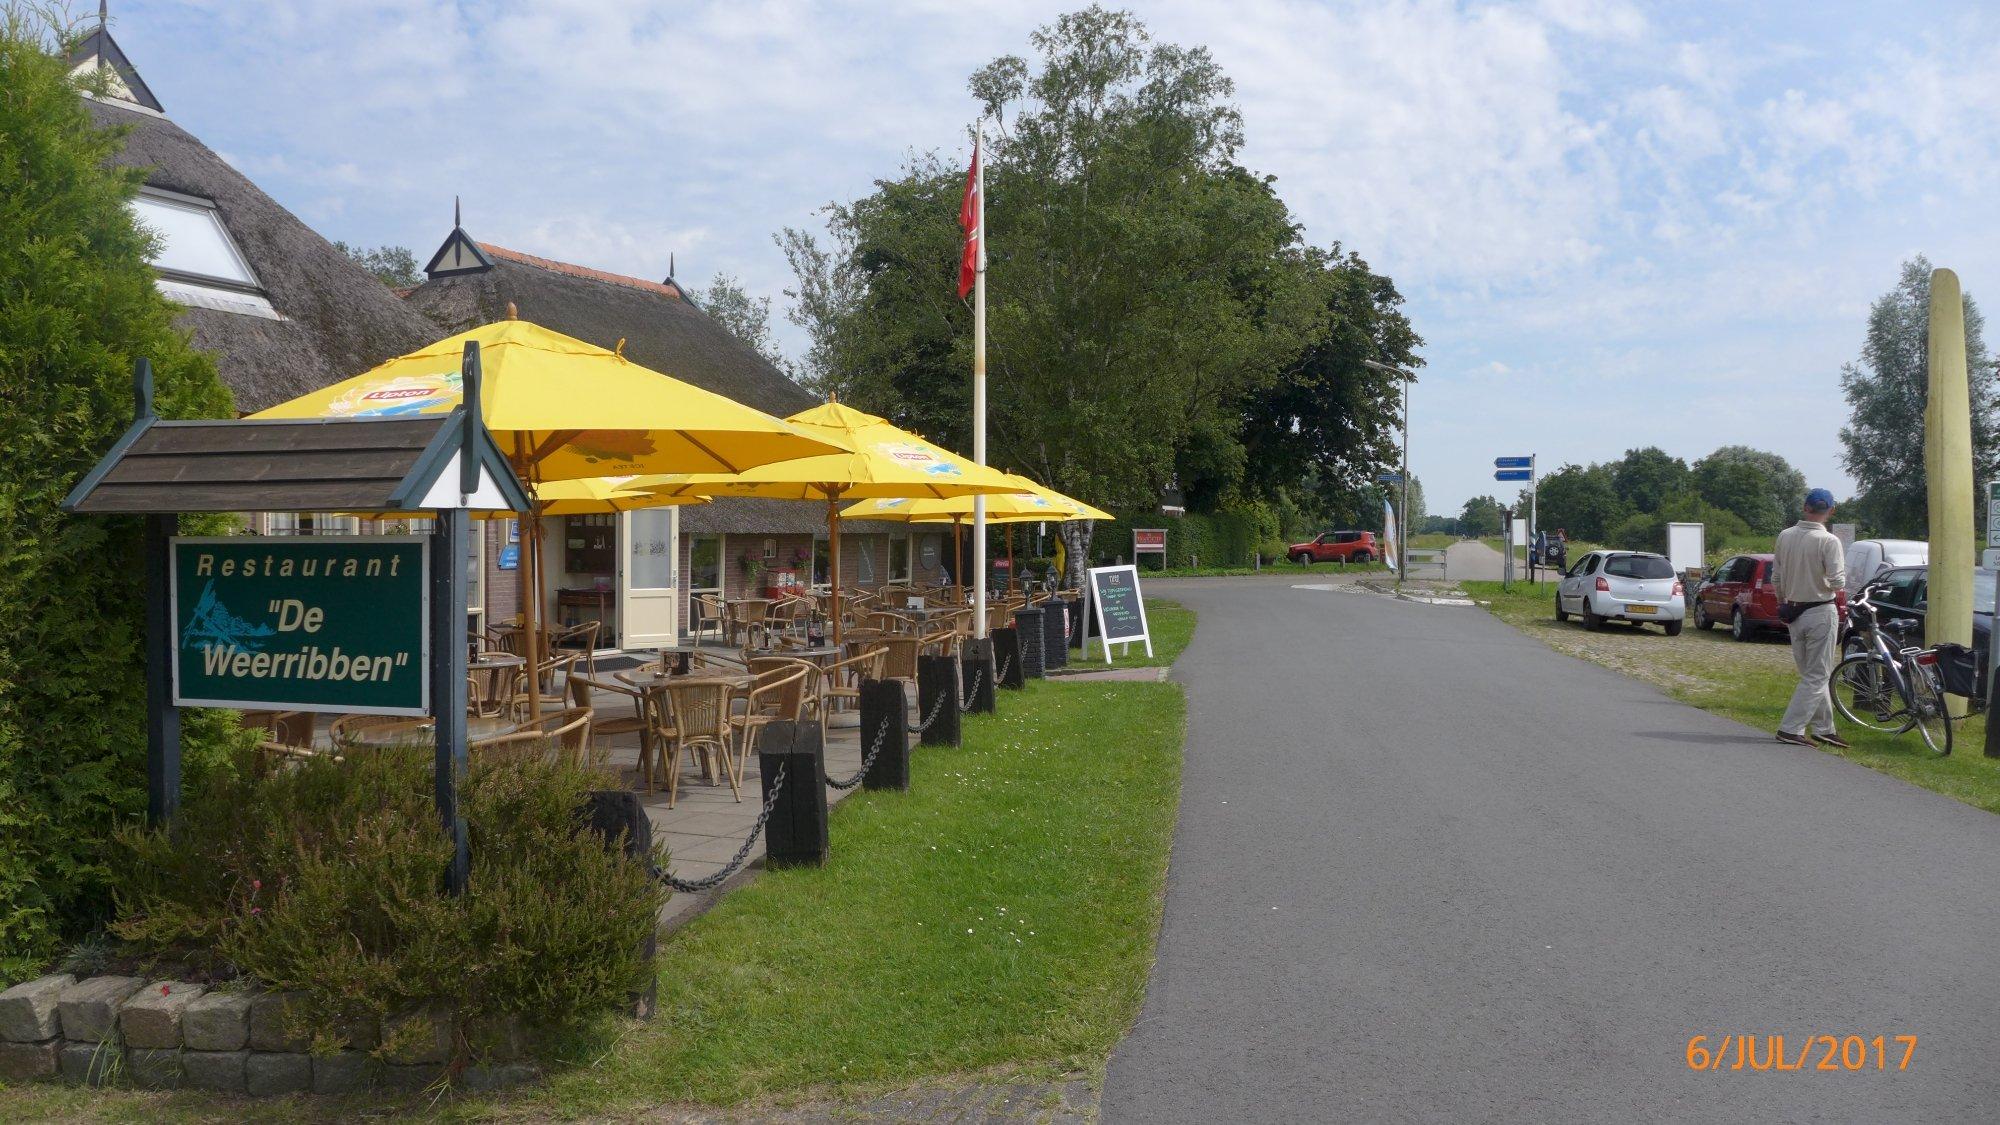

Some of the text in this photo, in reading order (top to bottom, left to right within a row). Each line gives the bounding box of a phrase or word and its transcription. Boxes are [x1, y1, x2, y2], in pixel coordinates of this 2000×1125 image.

[370, 389, 430, 399] Lipton
[196, 554, 401, 577] Restaurant
[268, 599, 324, 633] "De
[202, 644, 409, 682] Weerribben"
